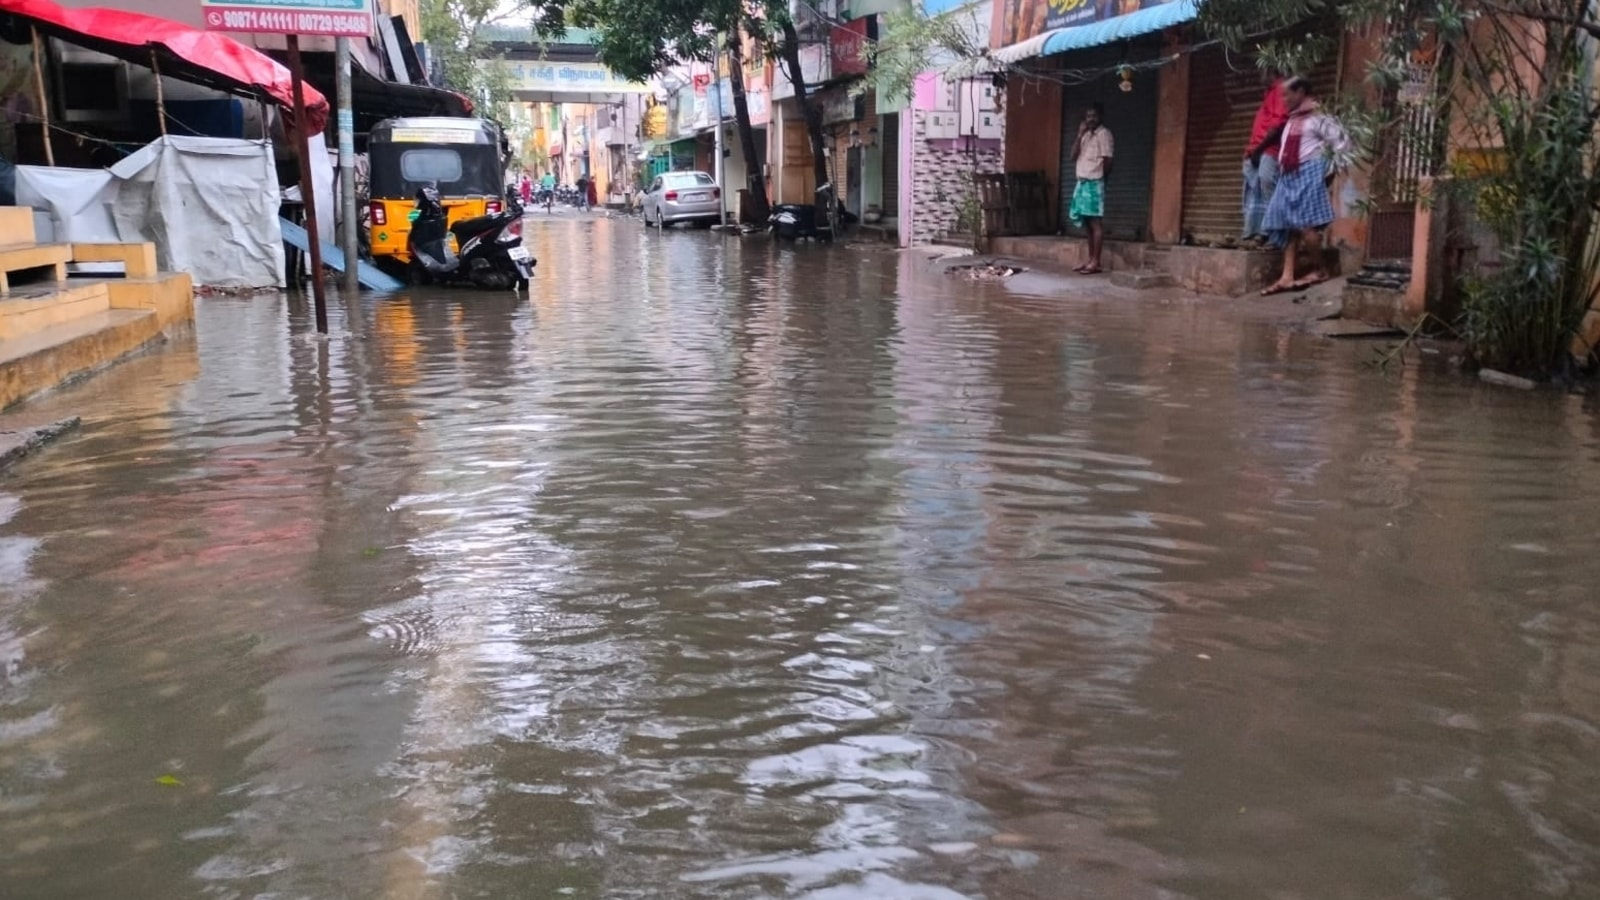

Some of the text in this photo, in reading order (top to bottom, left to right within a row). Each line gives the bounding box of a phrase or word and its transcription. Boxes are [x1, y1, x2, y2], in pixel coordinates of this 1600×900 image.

[224, 10, 258, 28] 90871
[260, 11, 293, 30] 41111
[299, 13, 333, 32] 80729
[529, 66, 554, 80] சக்தி
